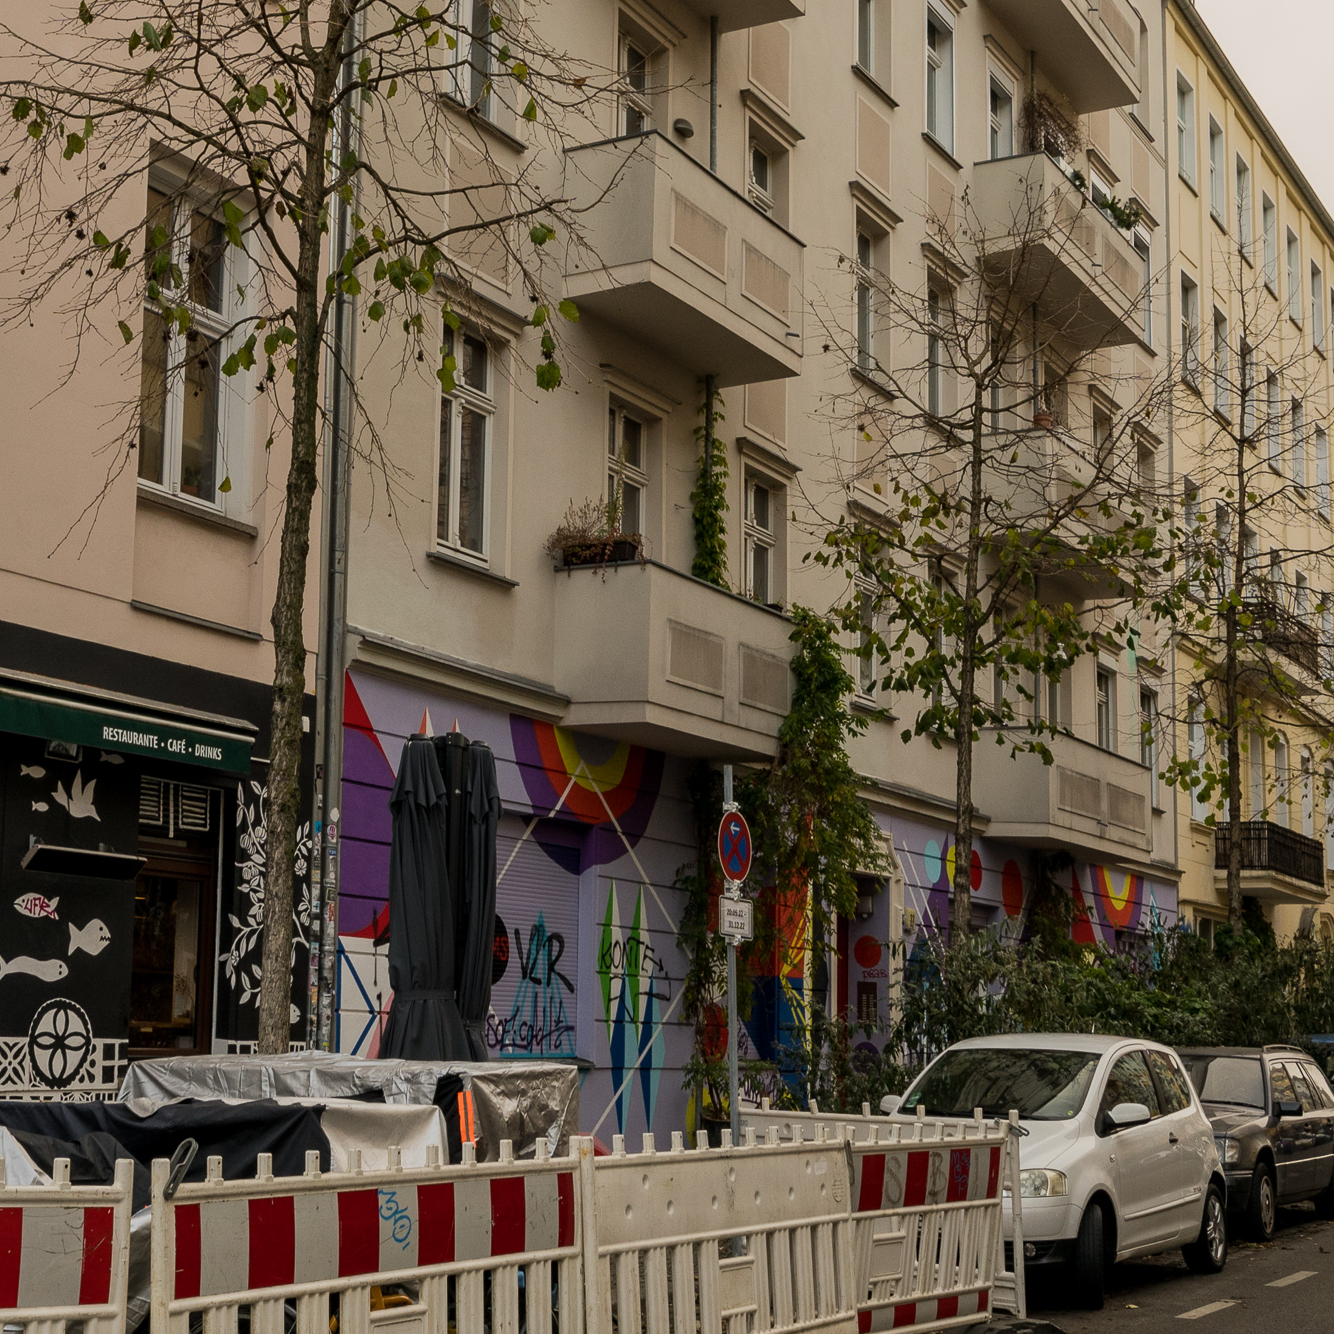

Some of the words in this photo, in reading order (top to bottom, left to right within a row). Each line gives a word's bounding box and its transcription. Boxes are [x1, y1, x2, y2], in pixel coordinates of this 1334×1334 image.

[102, 726, 159, 748] RESTAURANTE
[167, 738, 186, 754] CAFÉ
[194, 743, 222, 761] DRINKS
